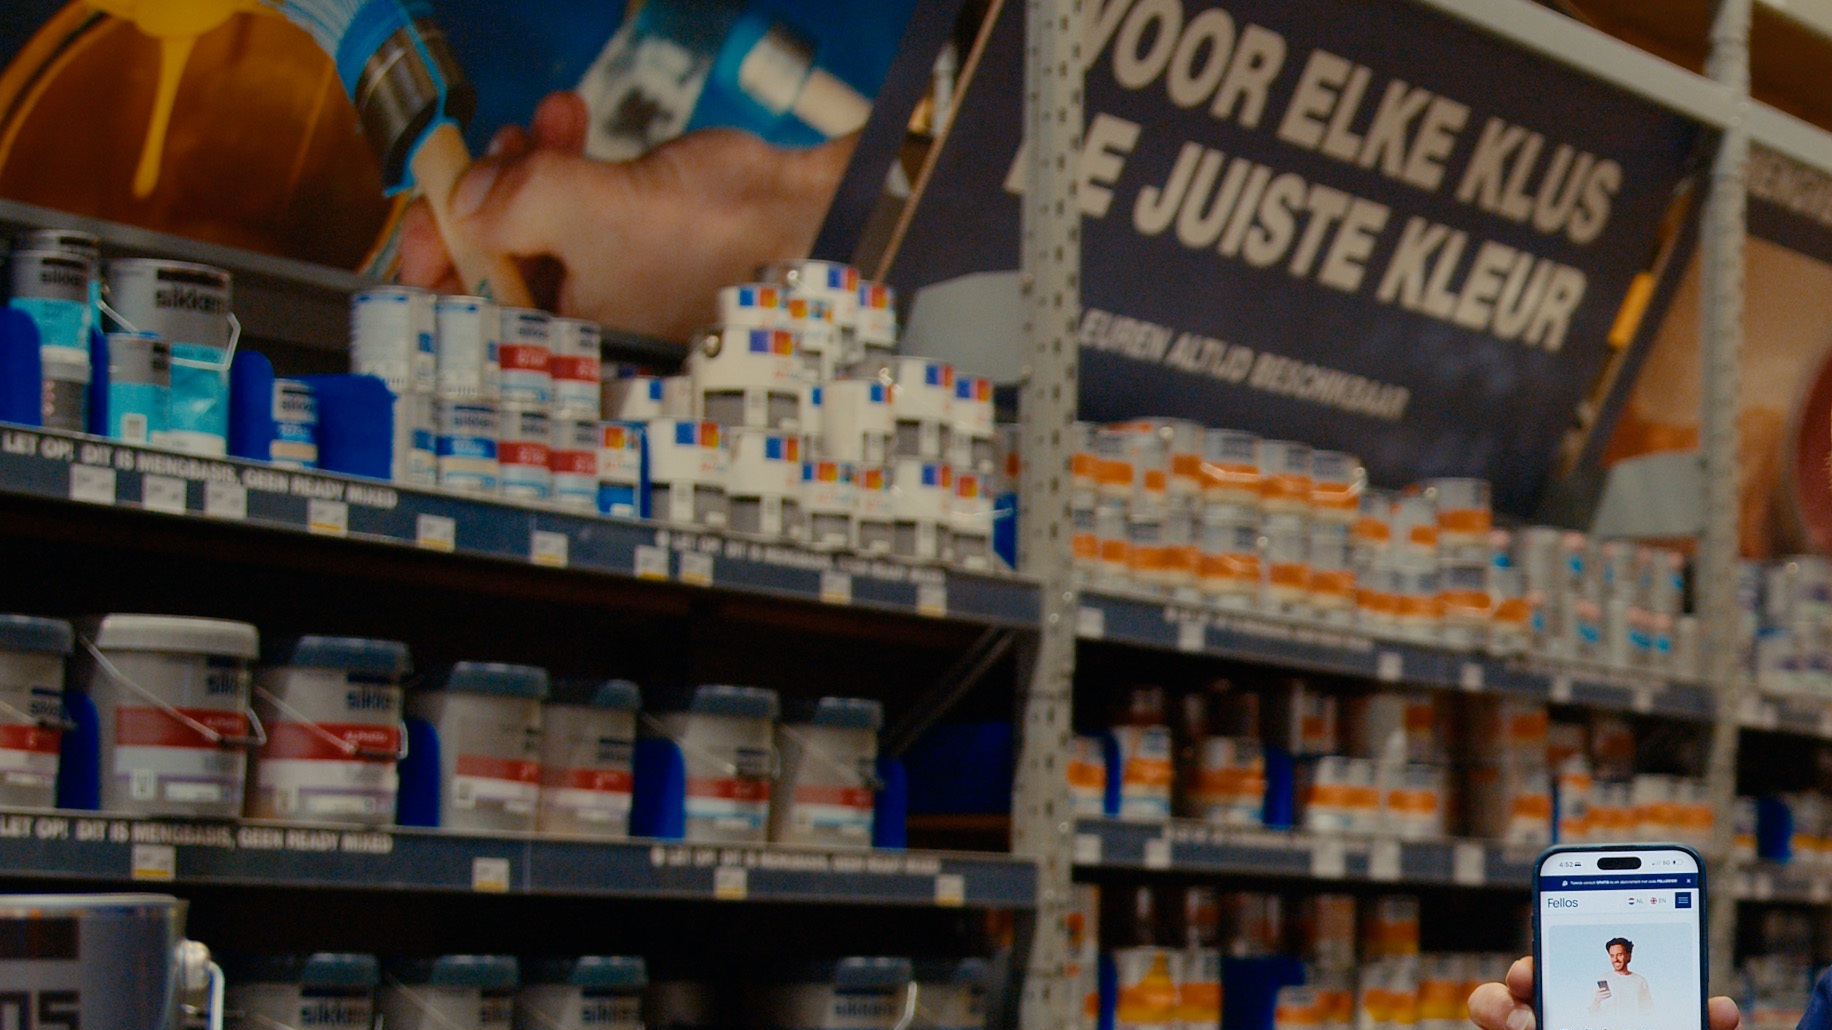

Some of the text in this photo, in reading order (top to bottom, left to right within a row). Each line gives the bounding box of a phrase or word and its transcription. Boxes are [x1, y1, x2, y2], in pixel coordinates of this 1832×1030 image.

[1277, 48, 1472, 192] ELKE
[1457, 117, 1622, 246] KLUS
[1133, 141, 1391, 292] JUISTE
[1376, 216, 1587, 352] KLEUR
[1079, 308, 1173, 363] EUREN
[1162, 330, 1255, 385] ALTIJD
[1, 430, 37, 455] LET
[81, 443, 111, 467] DIT
[115, 448, 135, 471] IS
[242, 469, 291, 495] GEEN
[290, 476, 345, 503] READY
[347, 484, 399, 510] MIXED
[0, 815, 33, 838] LET
[75, 820, 108, 843] DIT
[110, 822, 130, 844] IS
[237, 827, 285, 851] GEEN
[285, 830, 340, 853] READY
[341, 832, 394, 854] MIXED
[1547, 898, 1579, 908] Fellos
